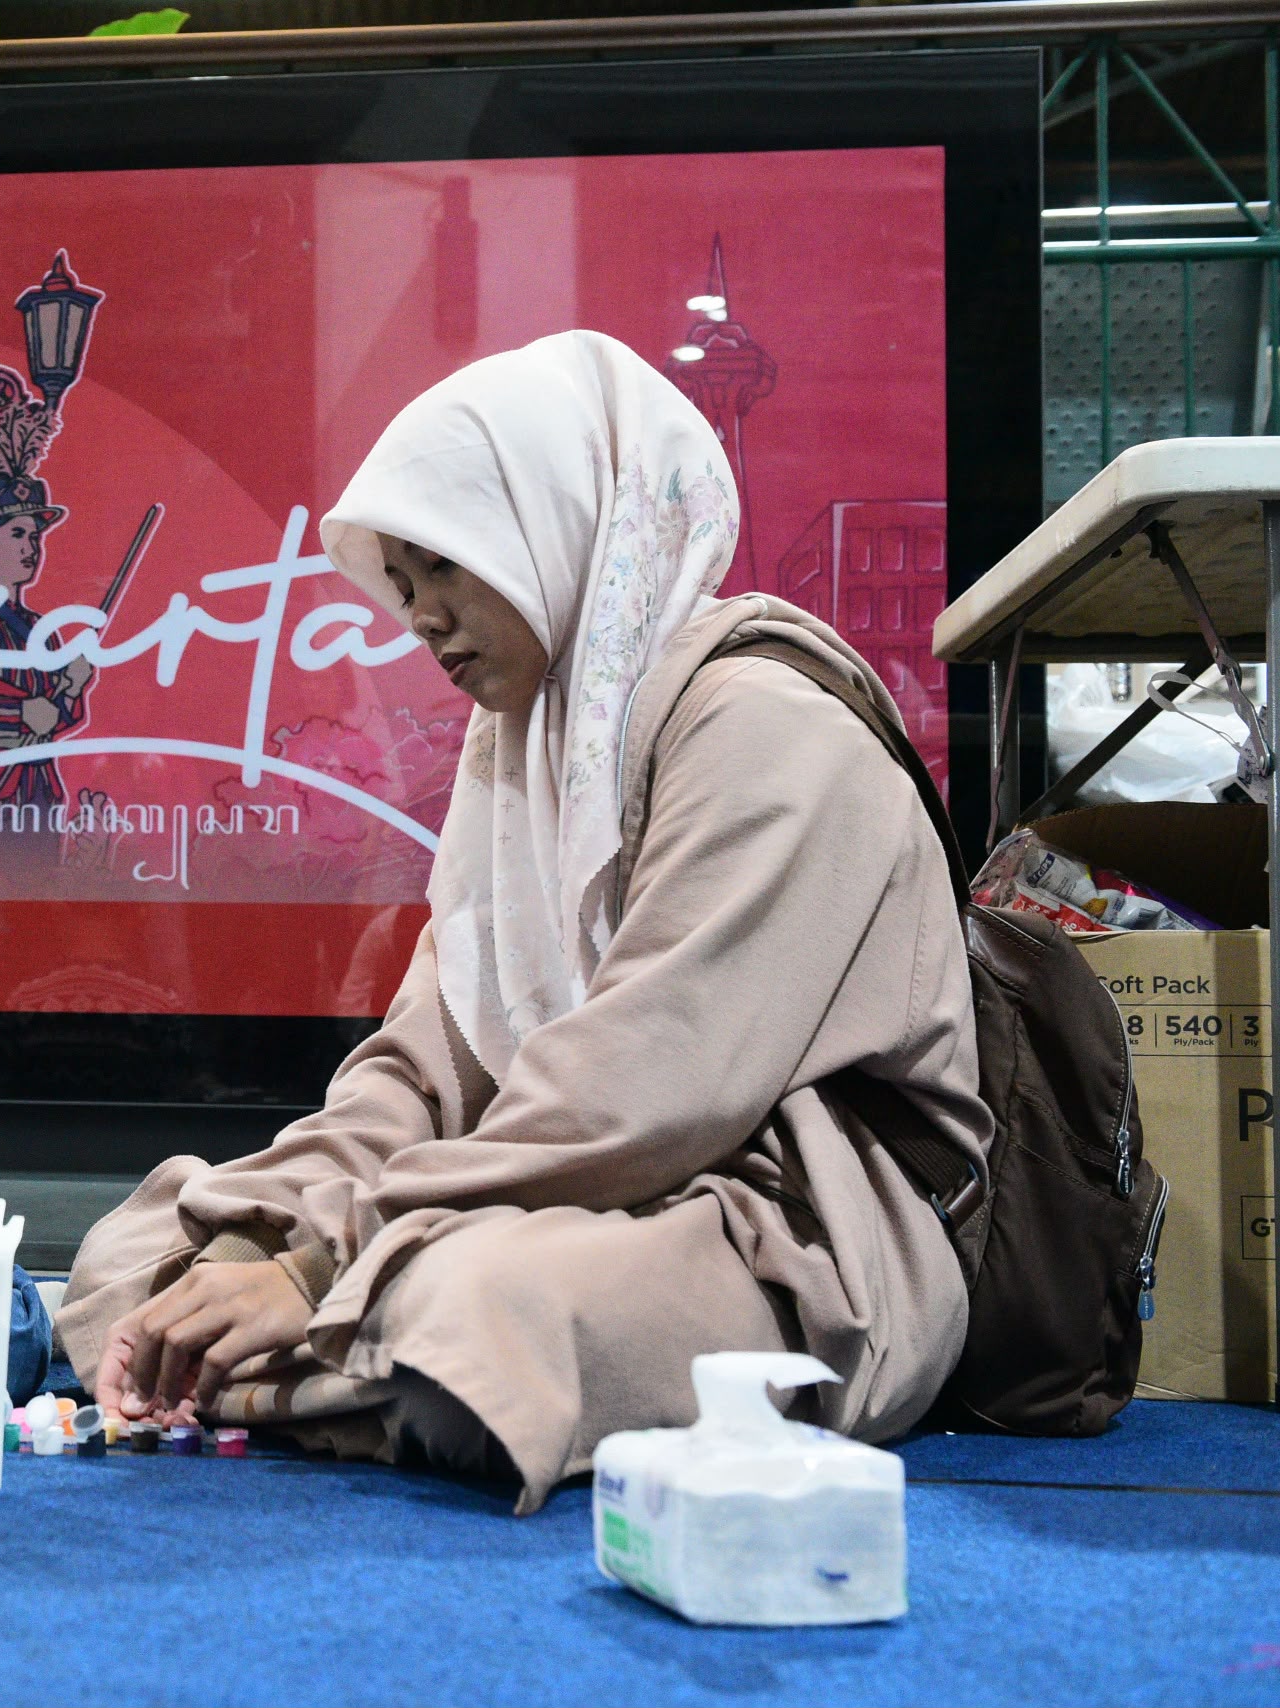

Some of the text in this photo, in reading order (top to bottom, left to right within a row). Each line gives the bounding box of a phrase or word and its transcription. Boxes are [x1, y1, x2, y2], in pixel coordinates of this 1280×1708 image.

[1153, 975, 1211, 994] Pack
[1165, 1015, 1223, 1036] 540
[1242, 1015, 1260, 1037] 3
[1174, 1038, 1215, 1047] Ply/Pack
[1244, 1038, 1259, 1048] Ply
[1250, 1216, 1276, 1238] G
